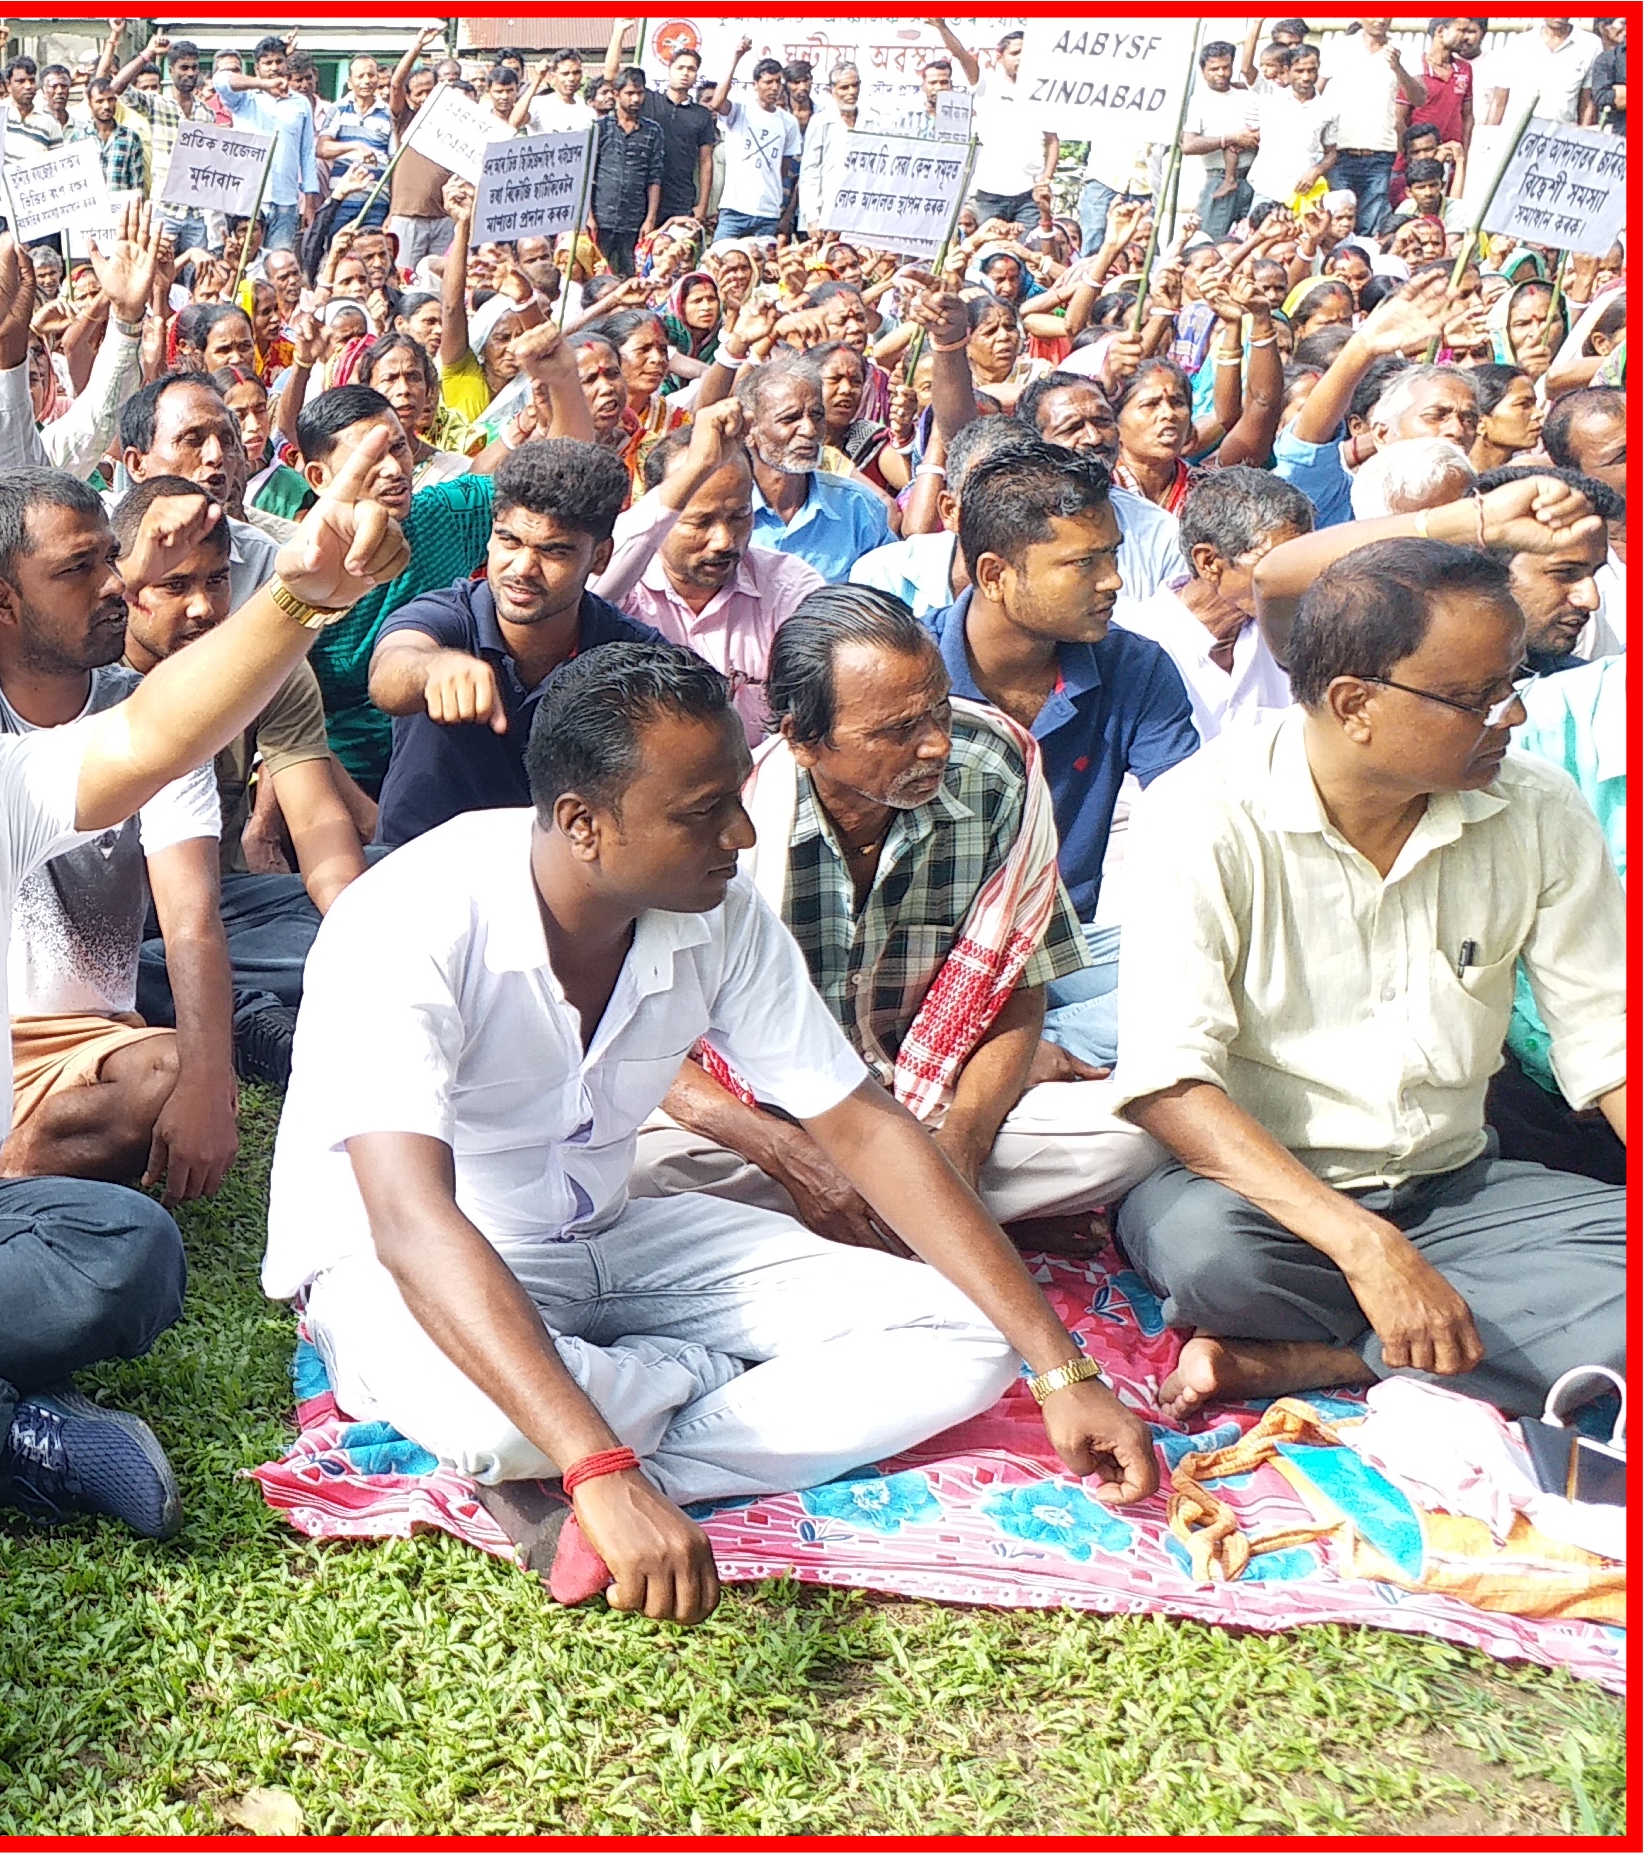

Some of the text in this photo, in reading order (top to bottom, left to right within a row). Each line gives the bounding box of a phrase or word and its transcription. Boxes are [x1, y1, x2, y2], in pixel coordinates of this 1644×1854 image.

[1052, 30, 1163, 61] AABYSF
[1028, 78, 1167, 112] ZINDABAD
[222, 140, 267, 162] হাজেলা
[1517, 132, 1551, 159] লোক
[1549, 136, 1600, 172] আদালতৰ
[189, 165, 245, 193] মুৰ্দাবাদ
[834, 189, 859, 208] লোক
[861, 191, 897, 213] আদালত
[1567, 182, 1609, 213] সমস্যা
[519, 207, 545, 229] প্ৰদান
[1514, 205, 1555, 231] সমাধান
